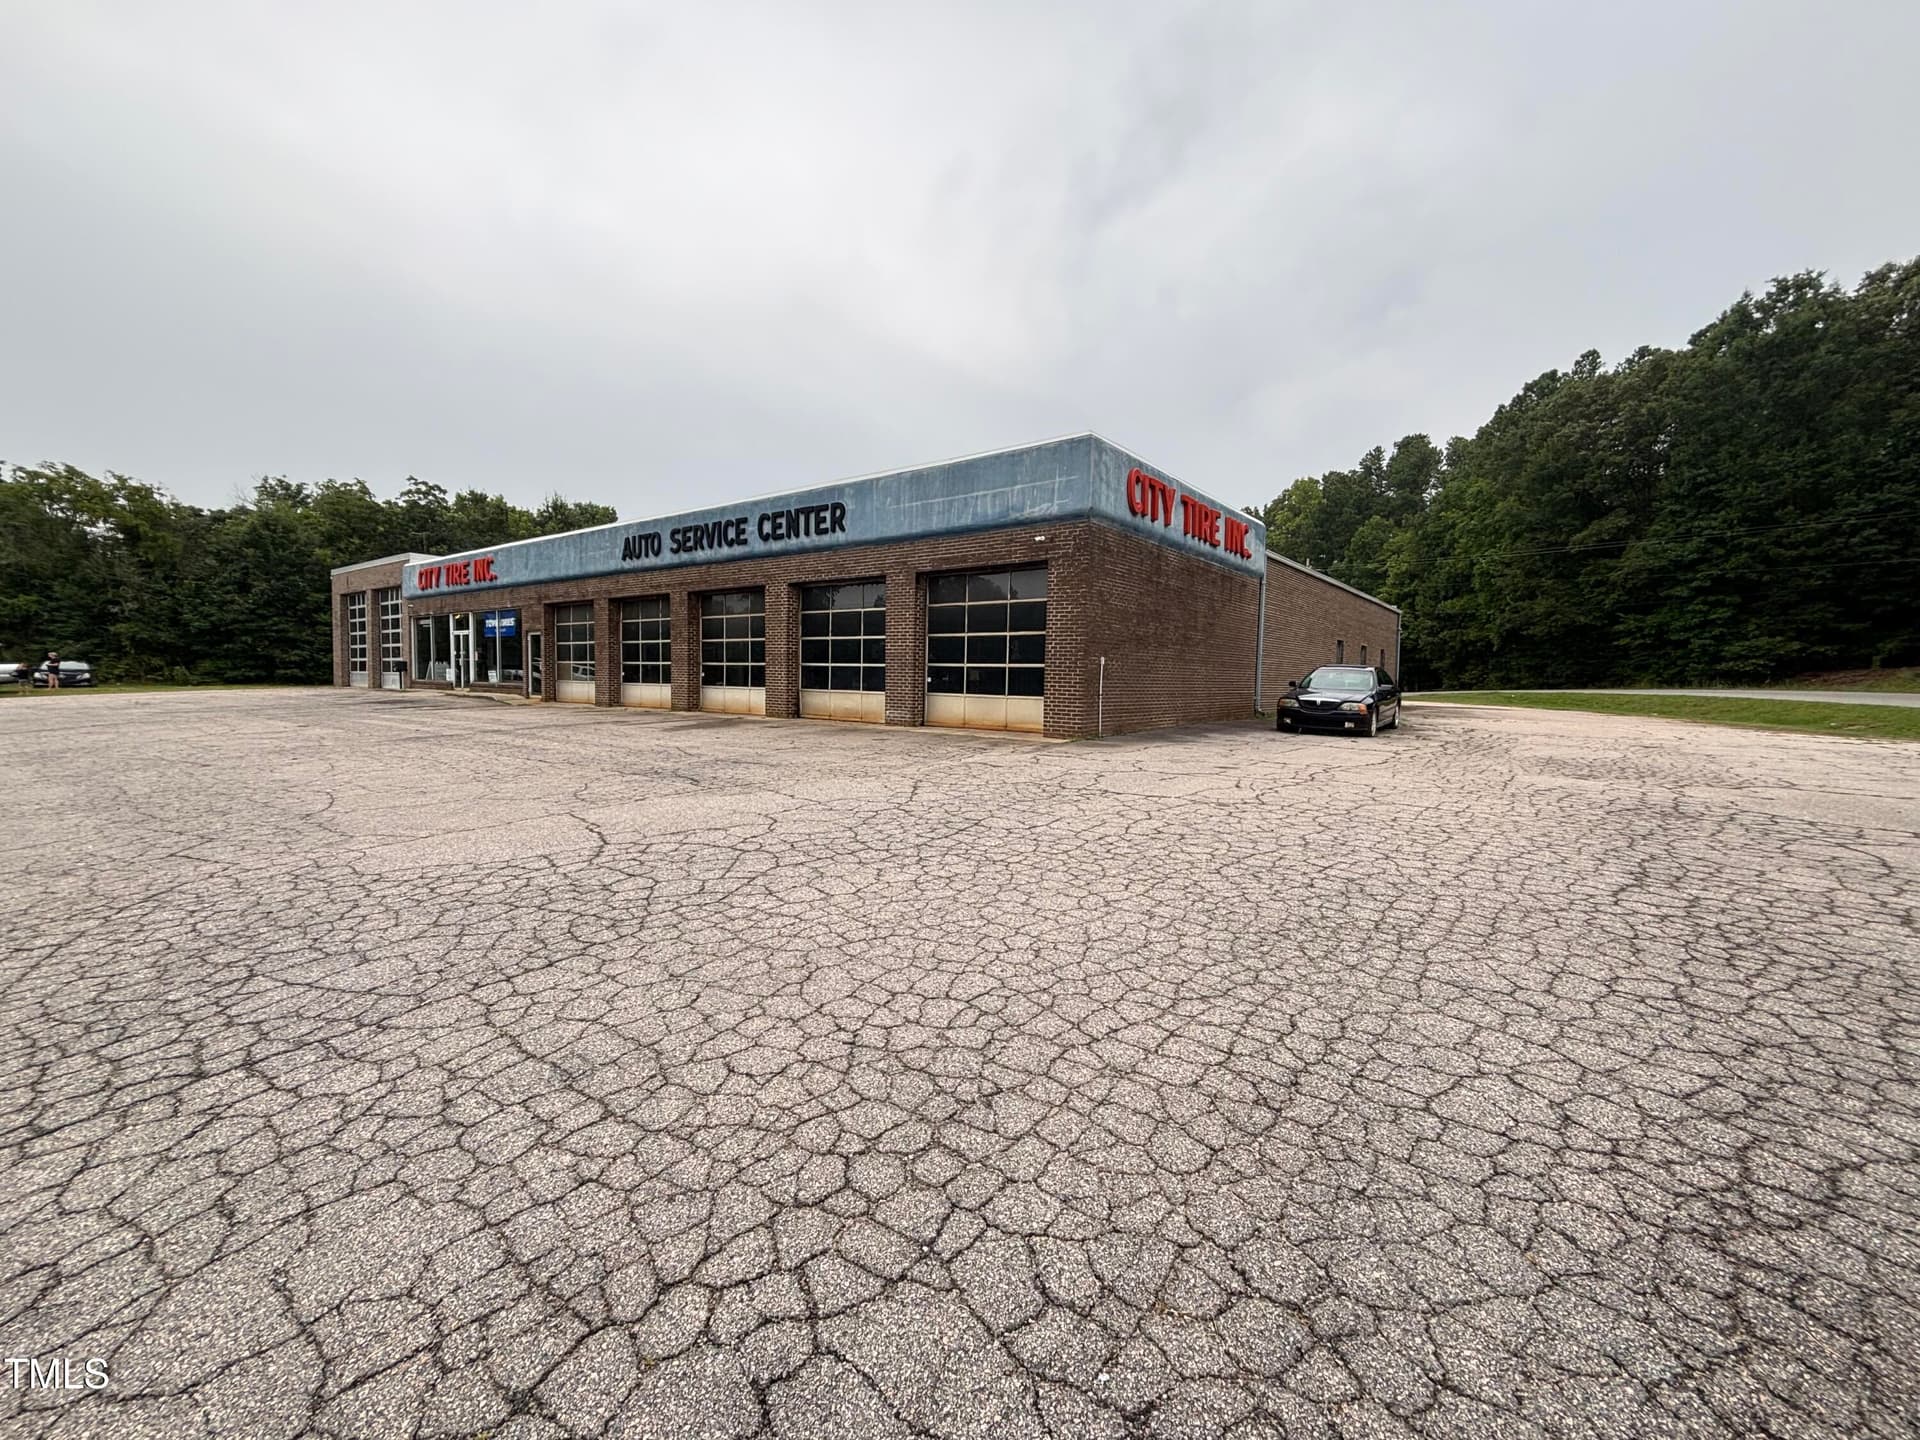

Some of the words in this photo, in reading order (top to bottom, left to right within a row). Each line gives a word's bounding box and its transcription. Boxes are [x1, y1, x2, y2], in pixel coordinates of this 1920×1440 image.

[621, 532, 661, 561] AUTO
[669, 517, 748, 554] SERVICE
[757, 502, 846, 542] CENTER
[1127, 468, 1176, 527] CITY
[1181, 494, 1221, 548] TIRE
[1224, 517, 1252, 560] INC.
[417, 566, 441, 591] CITY
[443, 561, 470, 587] TIRE
[473, 556, 497, 583] INC.
